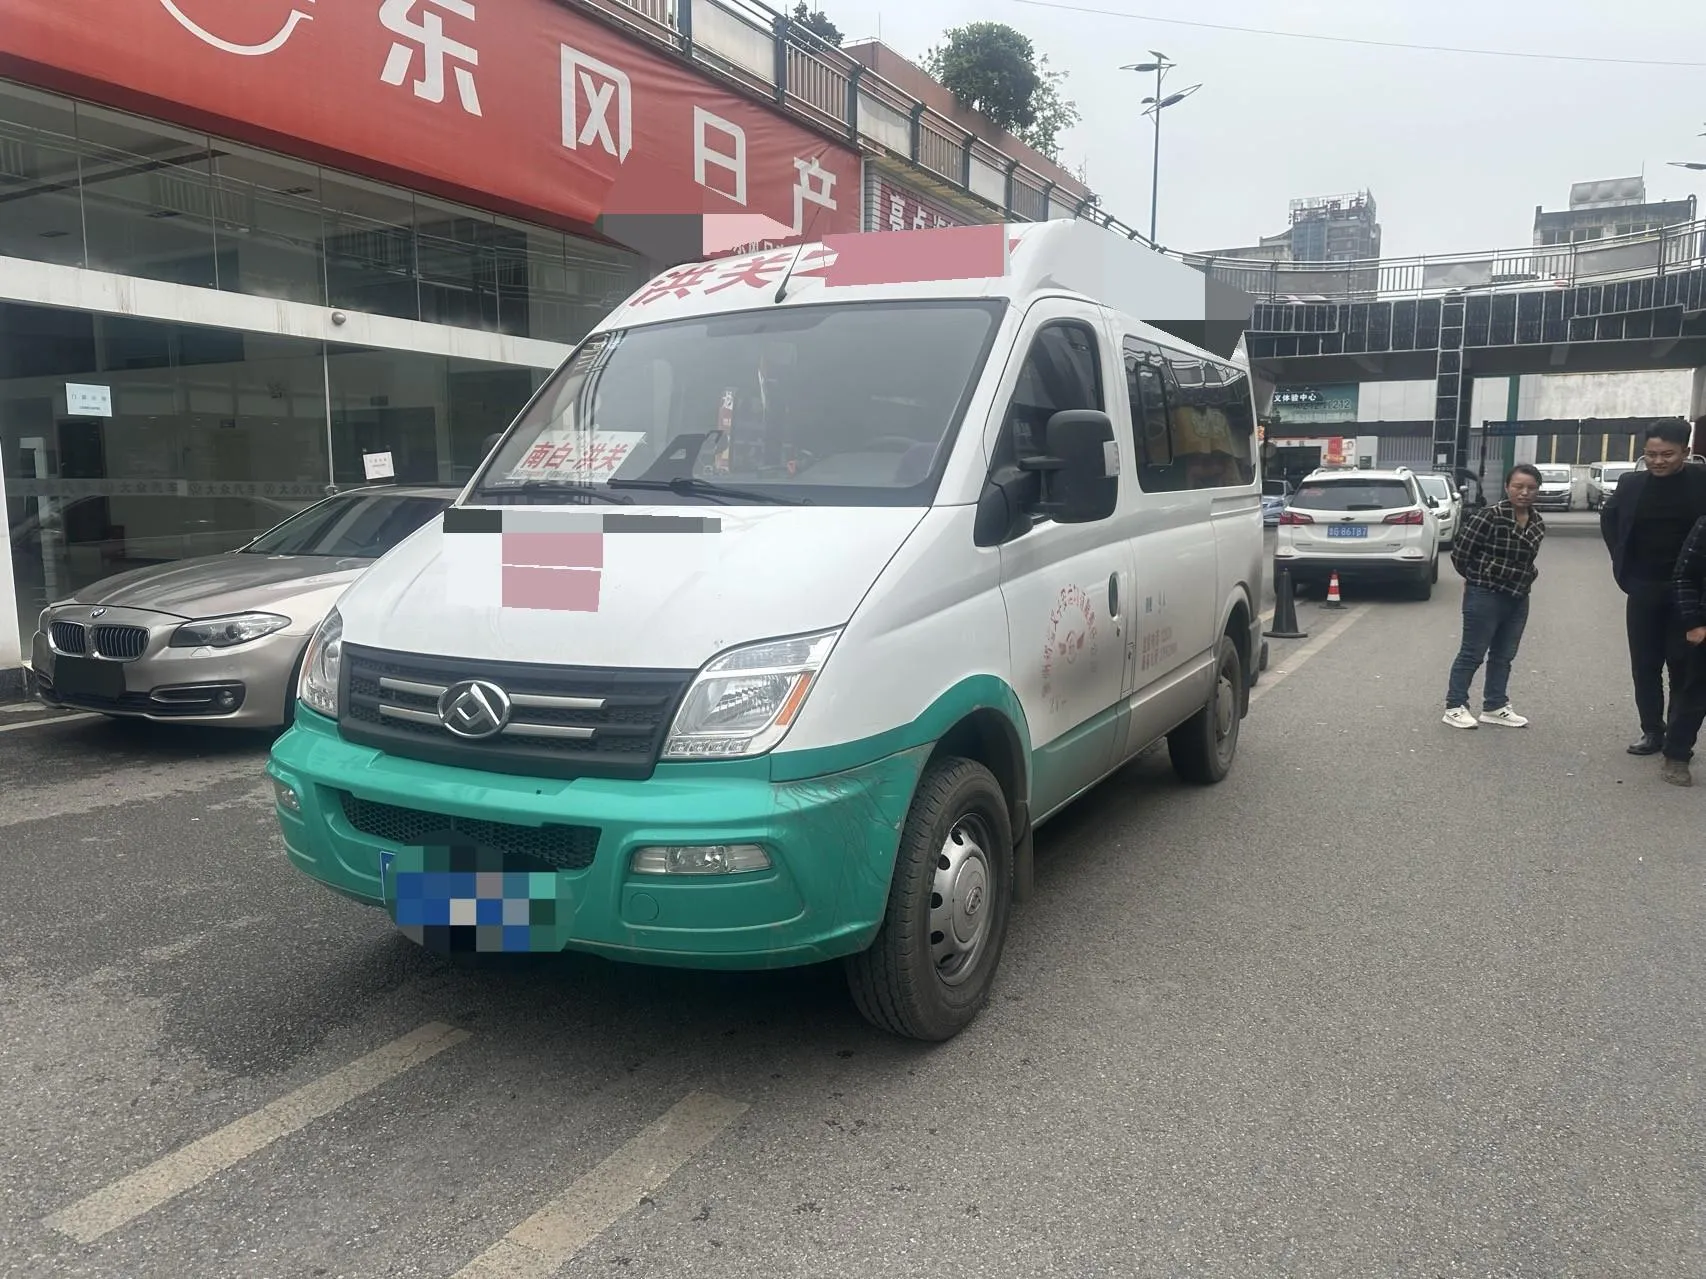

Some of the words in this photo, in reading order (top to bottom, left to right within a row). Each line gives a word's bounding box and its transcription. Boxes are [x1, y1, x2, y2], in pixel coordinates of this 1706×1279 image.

[379, 0, 837, 235] 东风日产
[890, 190, 954, 231] 亮点
[520, 441, 628, 471] 南白-洪关
